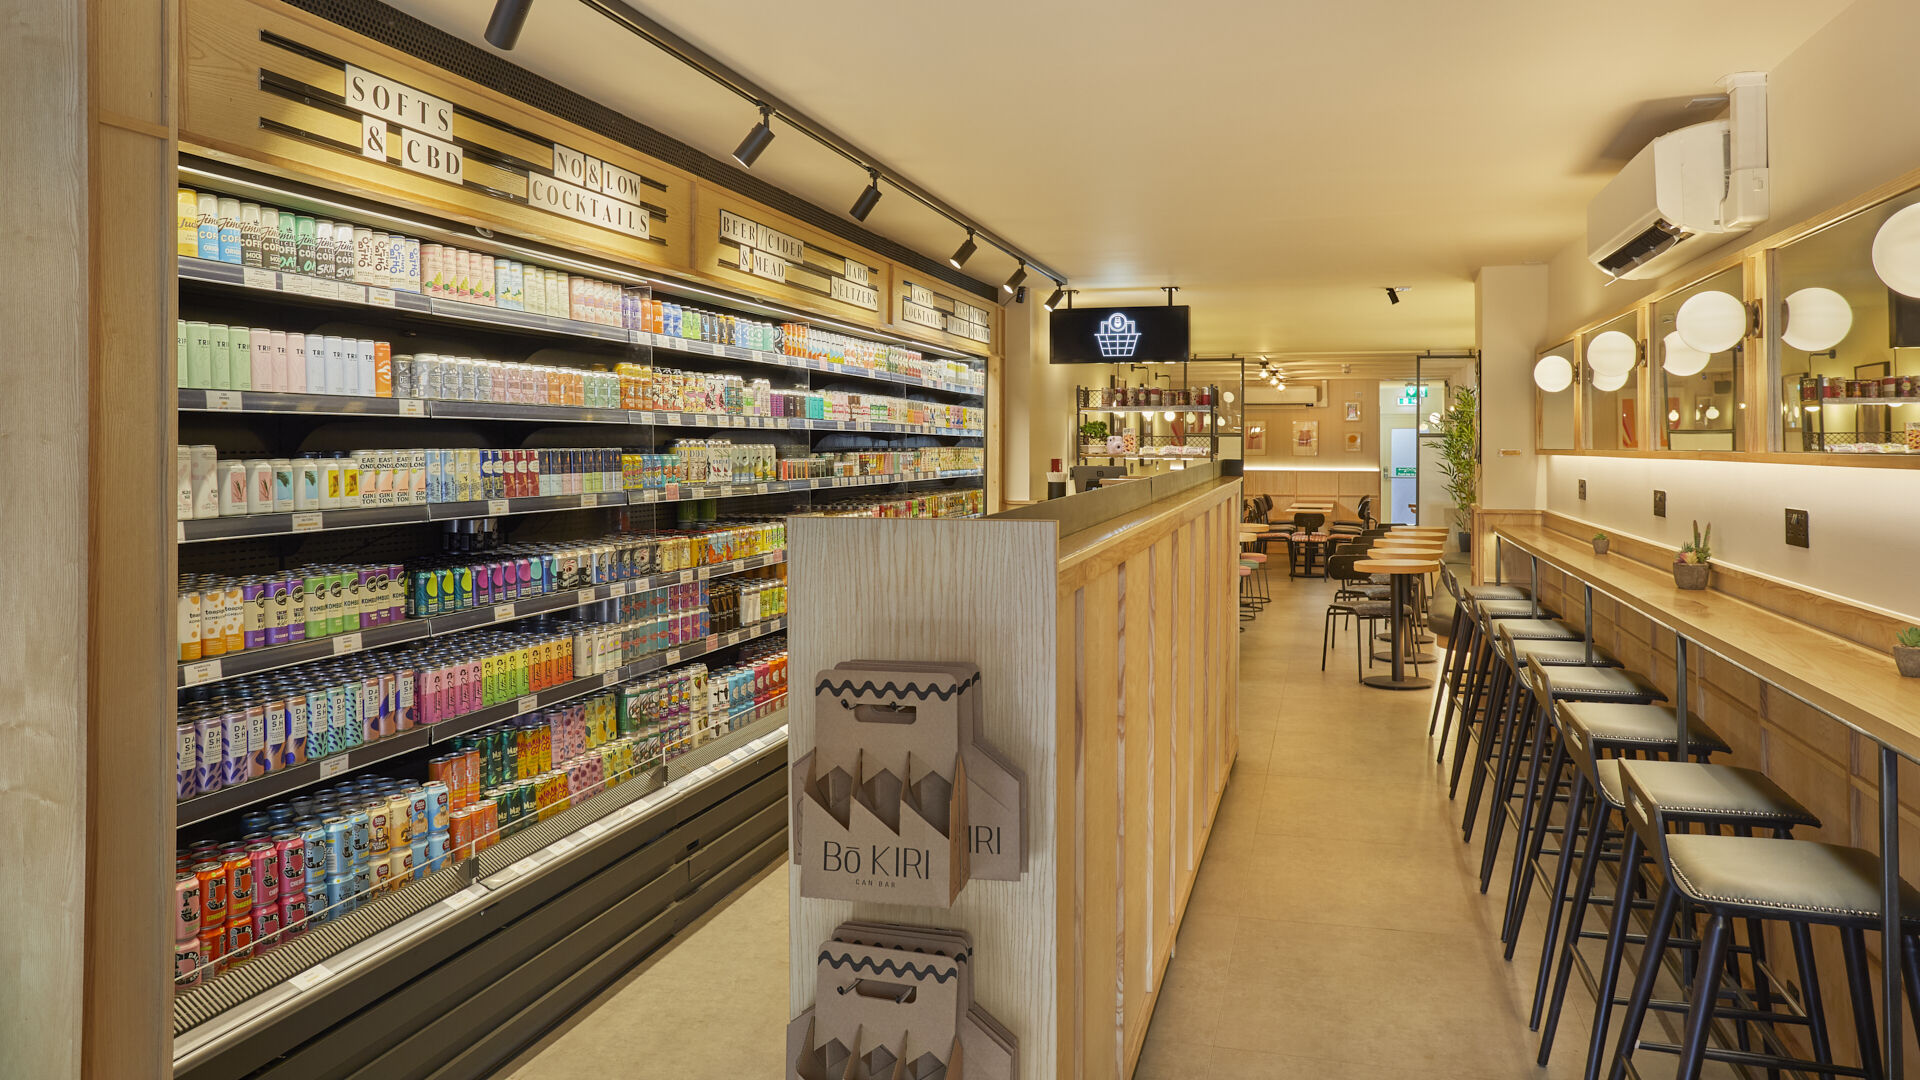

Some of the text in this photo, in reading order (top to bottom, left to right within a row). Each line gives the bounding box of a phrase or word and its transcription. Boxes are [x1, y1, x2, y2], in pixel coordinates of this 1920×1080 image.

[351, 75, 450, 133] SOFTS
[367, 126, 460, 176] & CBD
[532, 177, 647, 233] COCKTAILS
[742, 251, 784, 278] & MEAD
[846, 262, 868, 283] HARD
[832, 280, 877, 308] SELTZERS
[904, 304, 941, 324] COCKTAILS
[872, 844, 930, 880] KIRI
[855, 878, 896, 889] CAN BAR
